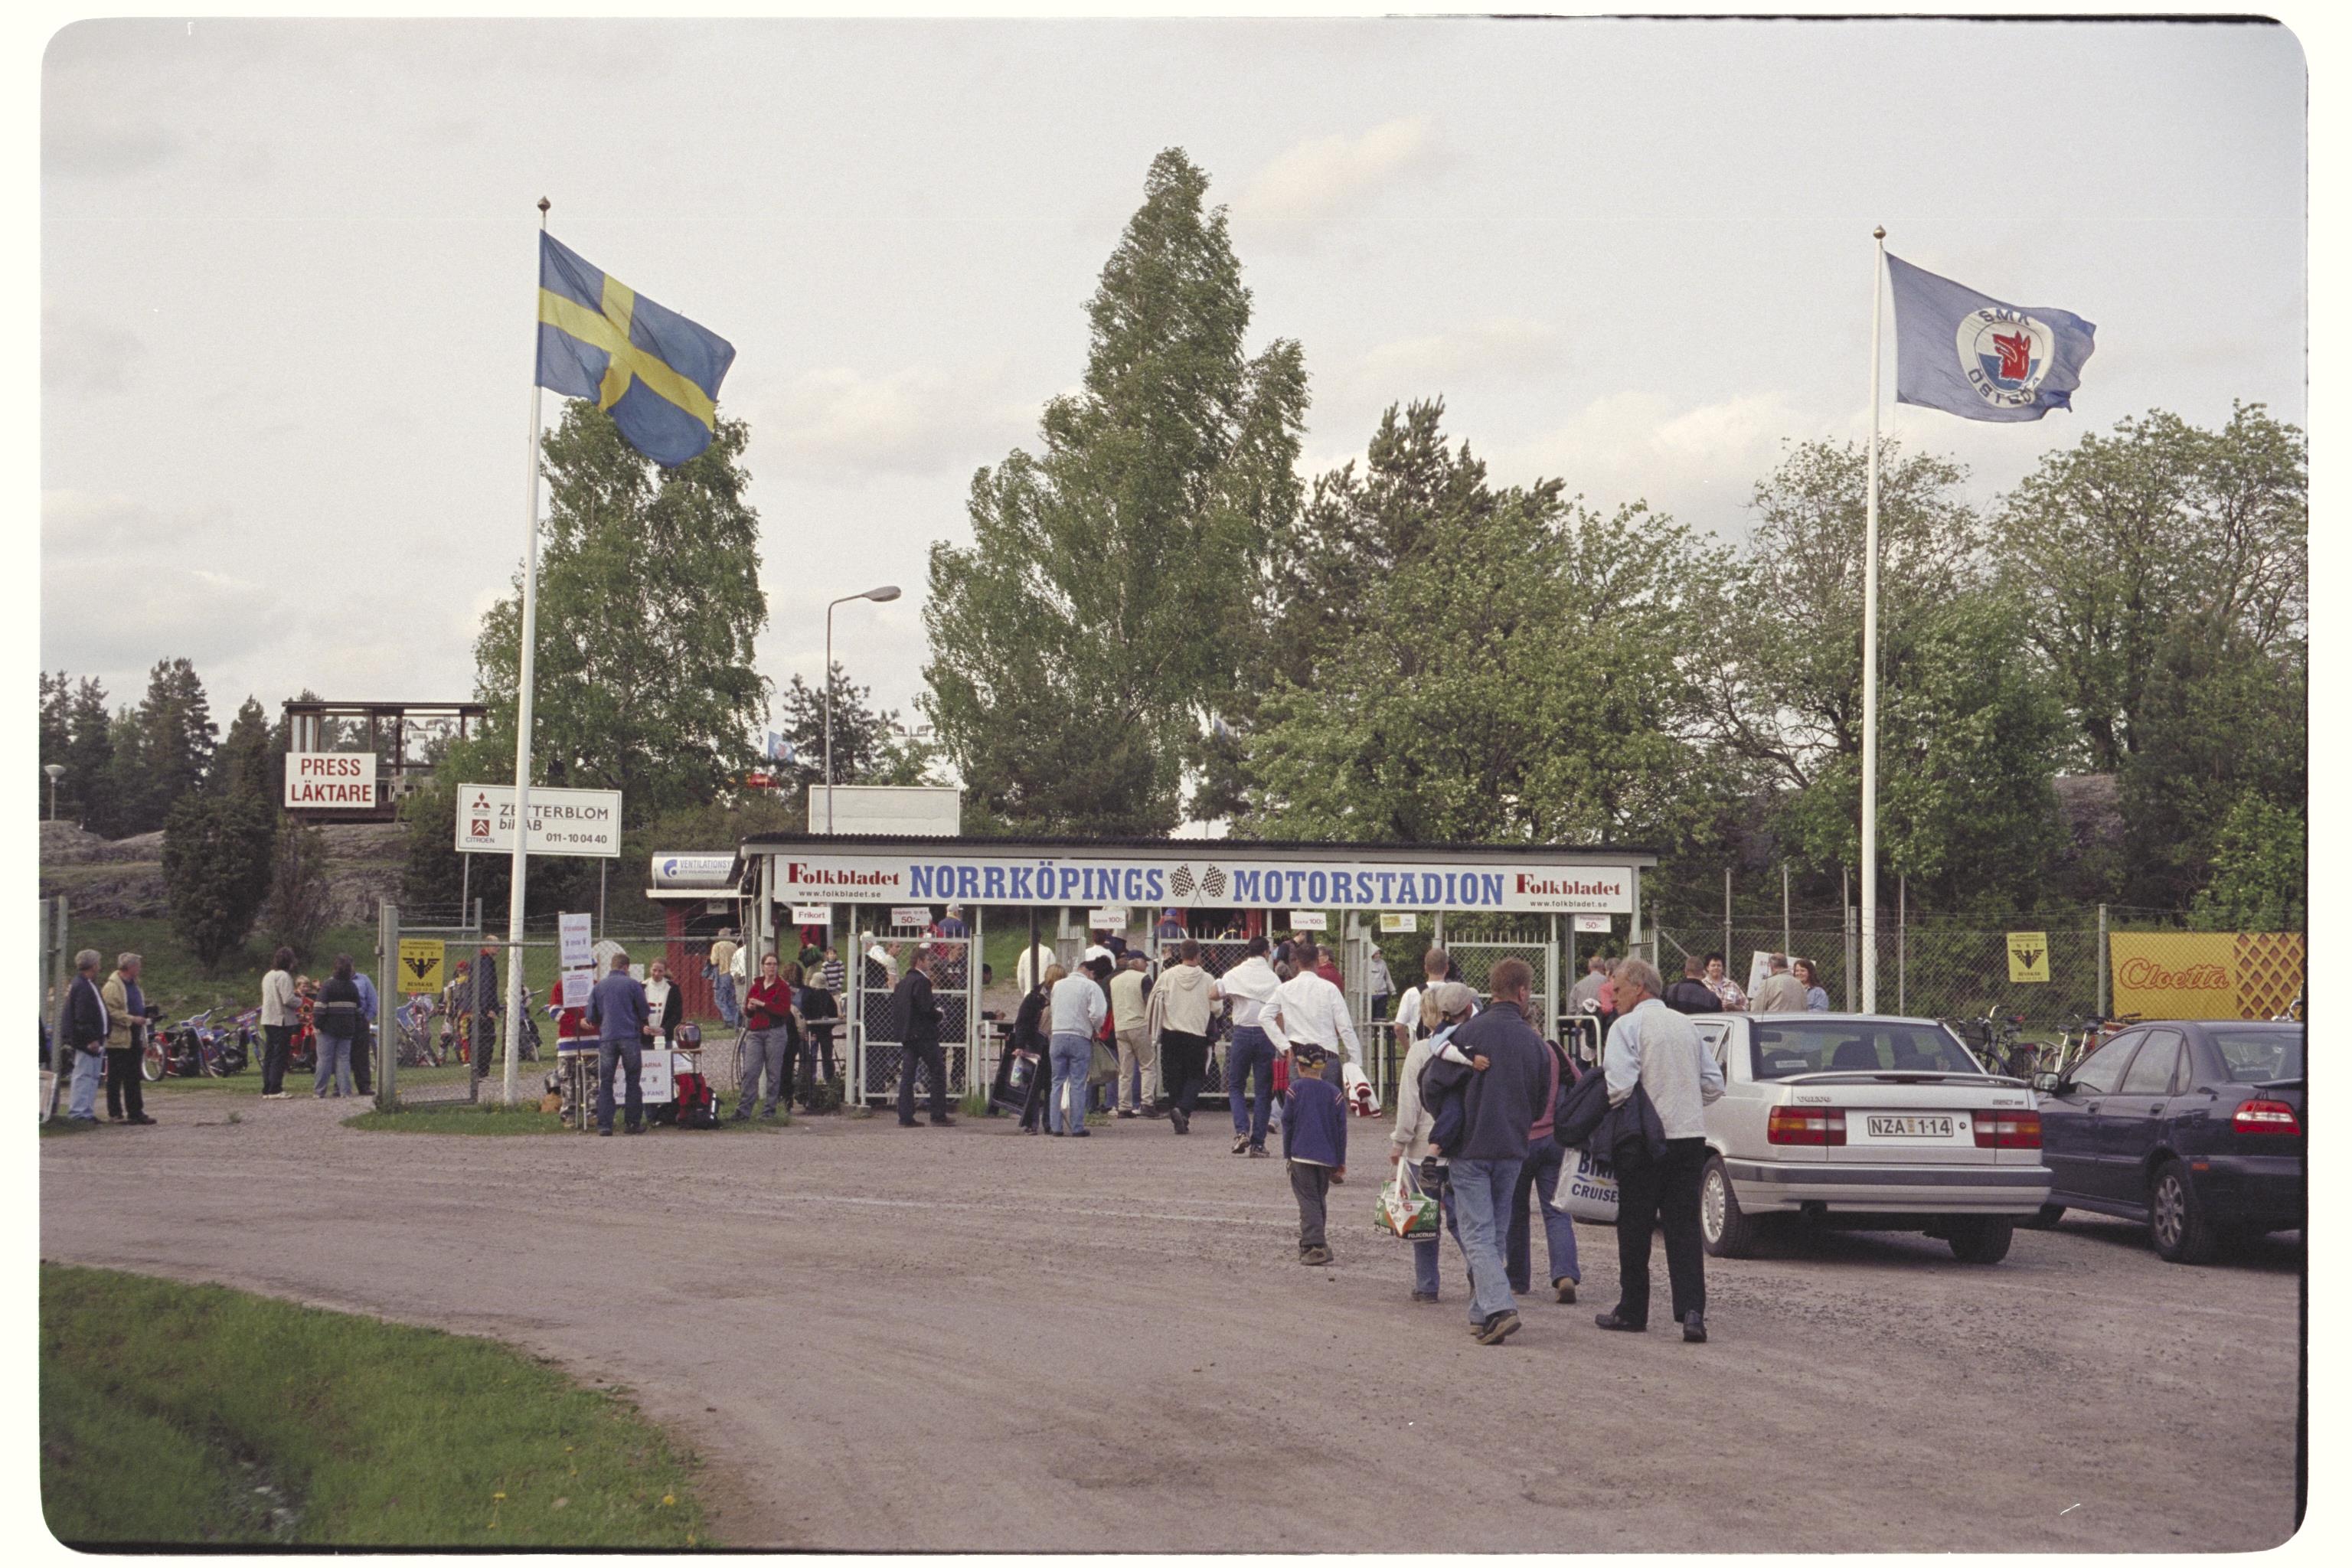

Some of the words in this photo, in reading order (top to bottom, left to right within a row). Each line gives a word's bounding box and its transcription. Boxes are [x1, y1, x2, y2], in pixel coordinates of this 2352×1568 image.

[301, 758, 361, 776] PRESS
[291, 779, 372, 802] LÄKTARE
[787, 862, 900, 886] Folkbladet
[909, 861, 1165, 901] NORRKÖPINGS
[1233, 870, 1505, 906] MOTORSTADION
[1515, 874, 1622, 896] Folkbladet
[799, 890, 881, 898] www.folkbladet.se
[798, 911, 825, 920] Frikort
[2119, 957, 2230, 990] Cloetta
[1871, 1119, 1906, 1134] NZA
[1918, 1119, 1951, 1134] 114
